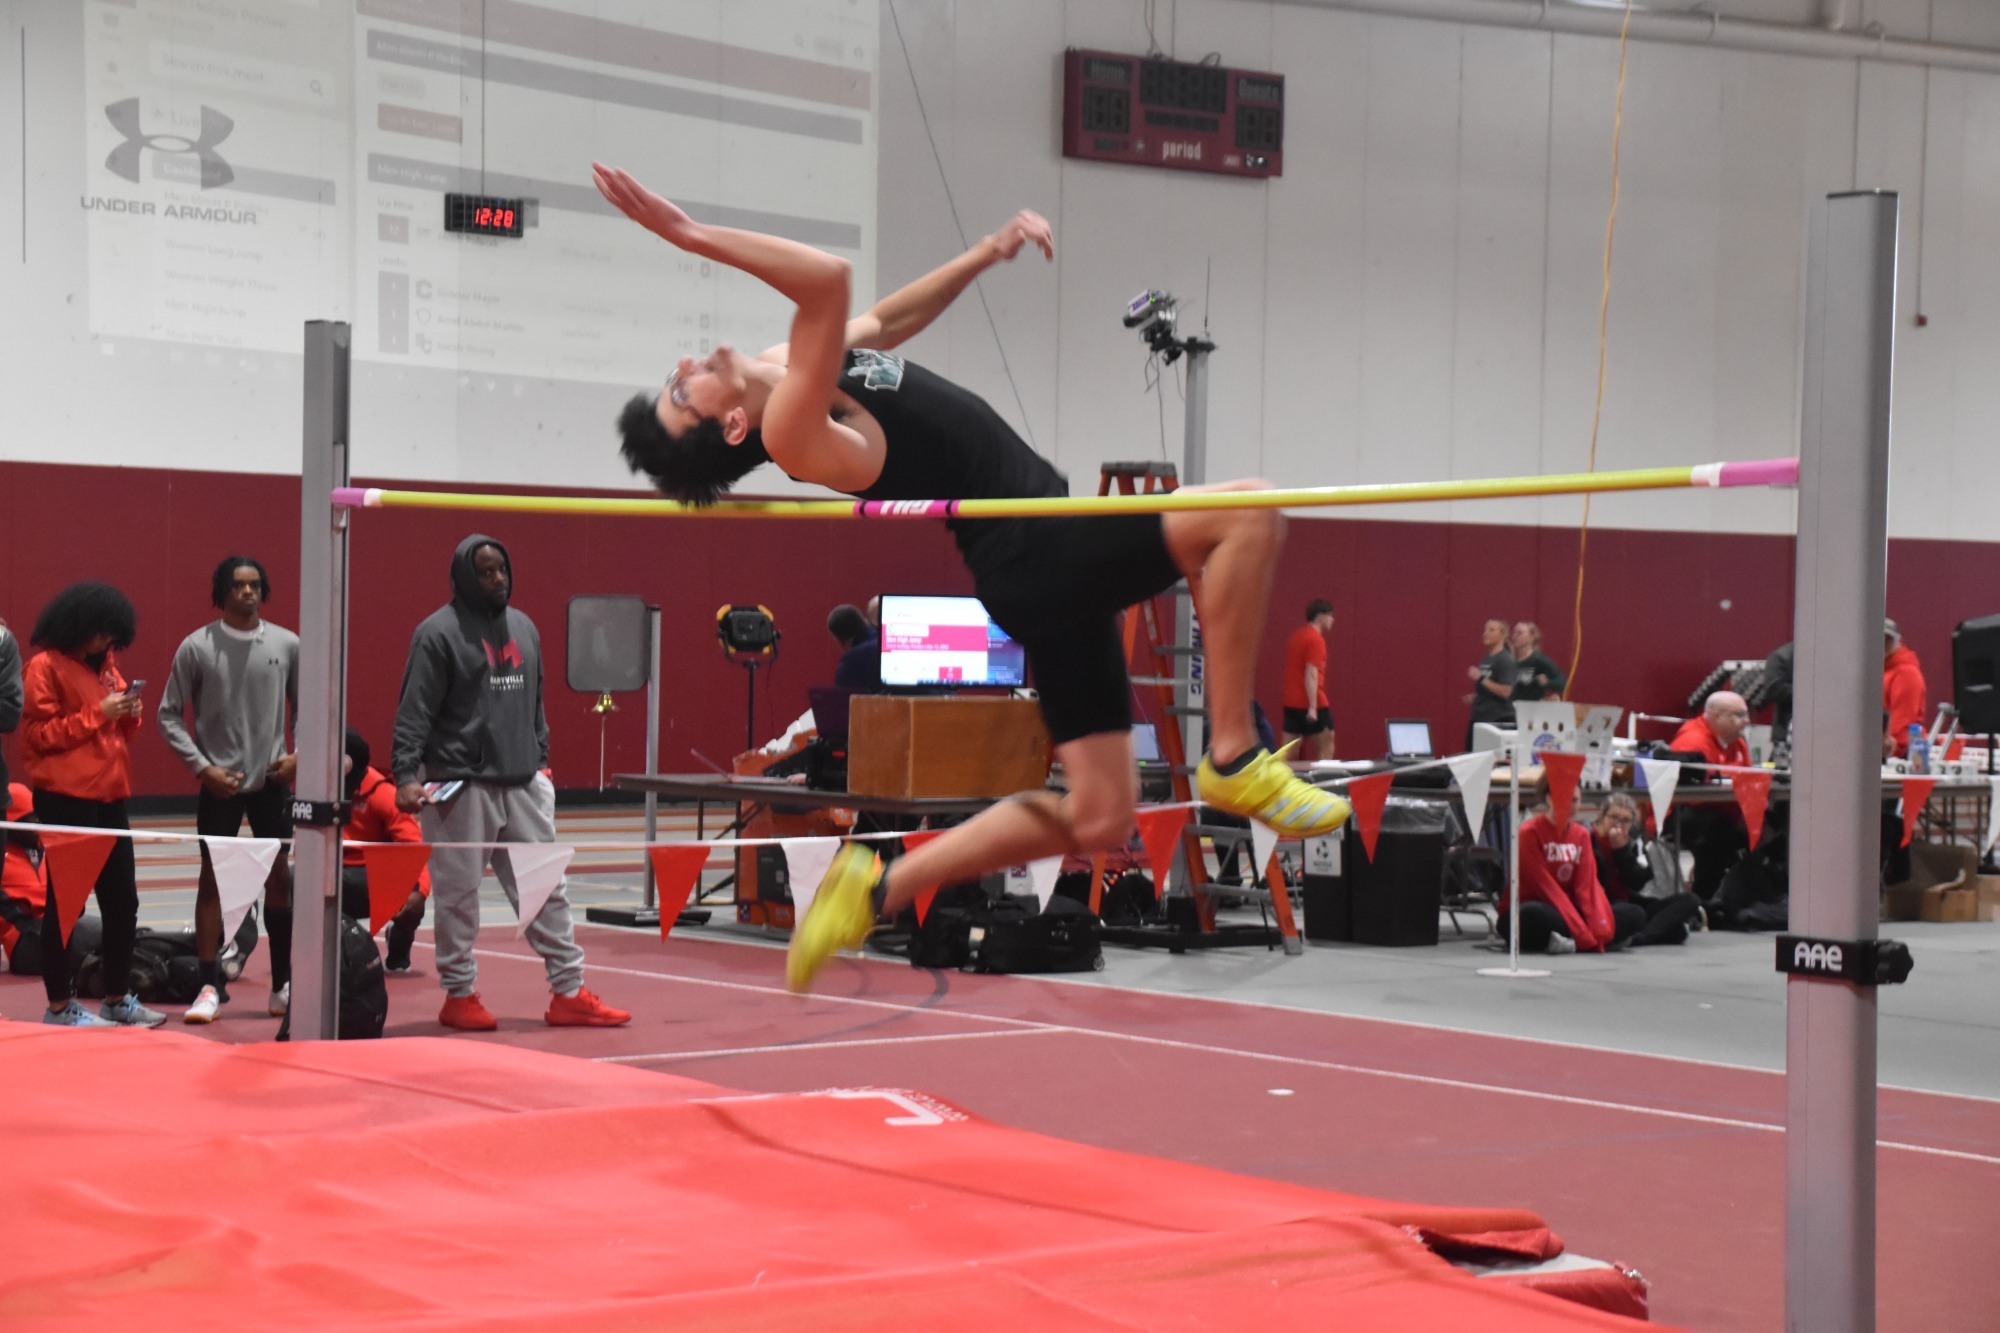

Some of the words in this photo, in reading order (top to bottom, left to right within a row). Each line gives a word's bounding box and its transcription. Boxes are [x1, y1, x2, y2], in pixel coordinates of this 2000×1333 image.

[1162, 140, 1202, 161] period
[80, 195, 157, 217] UNDER
[163, 203, 258, 226] ARMOUR
[474, 207, 514, 228] 12:28
